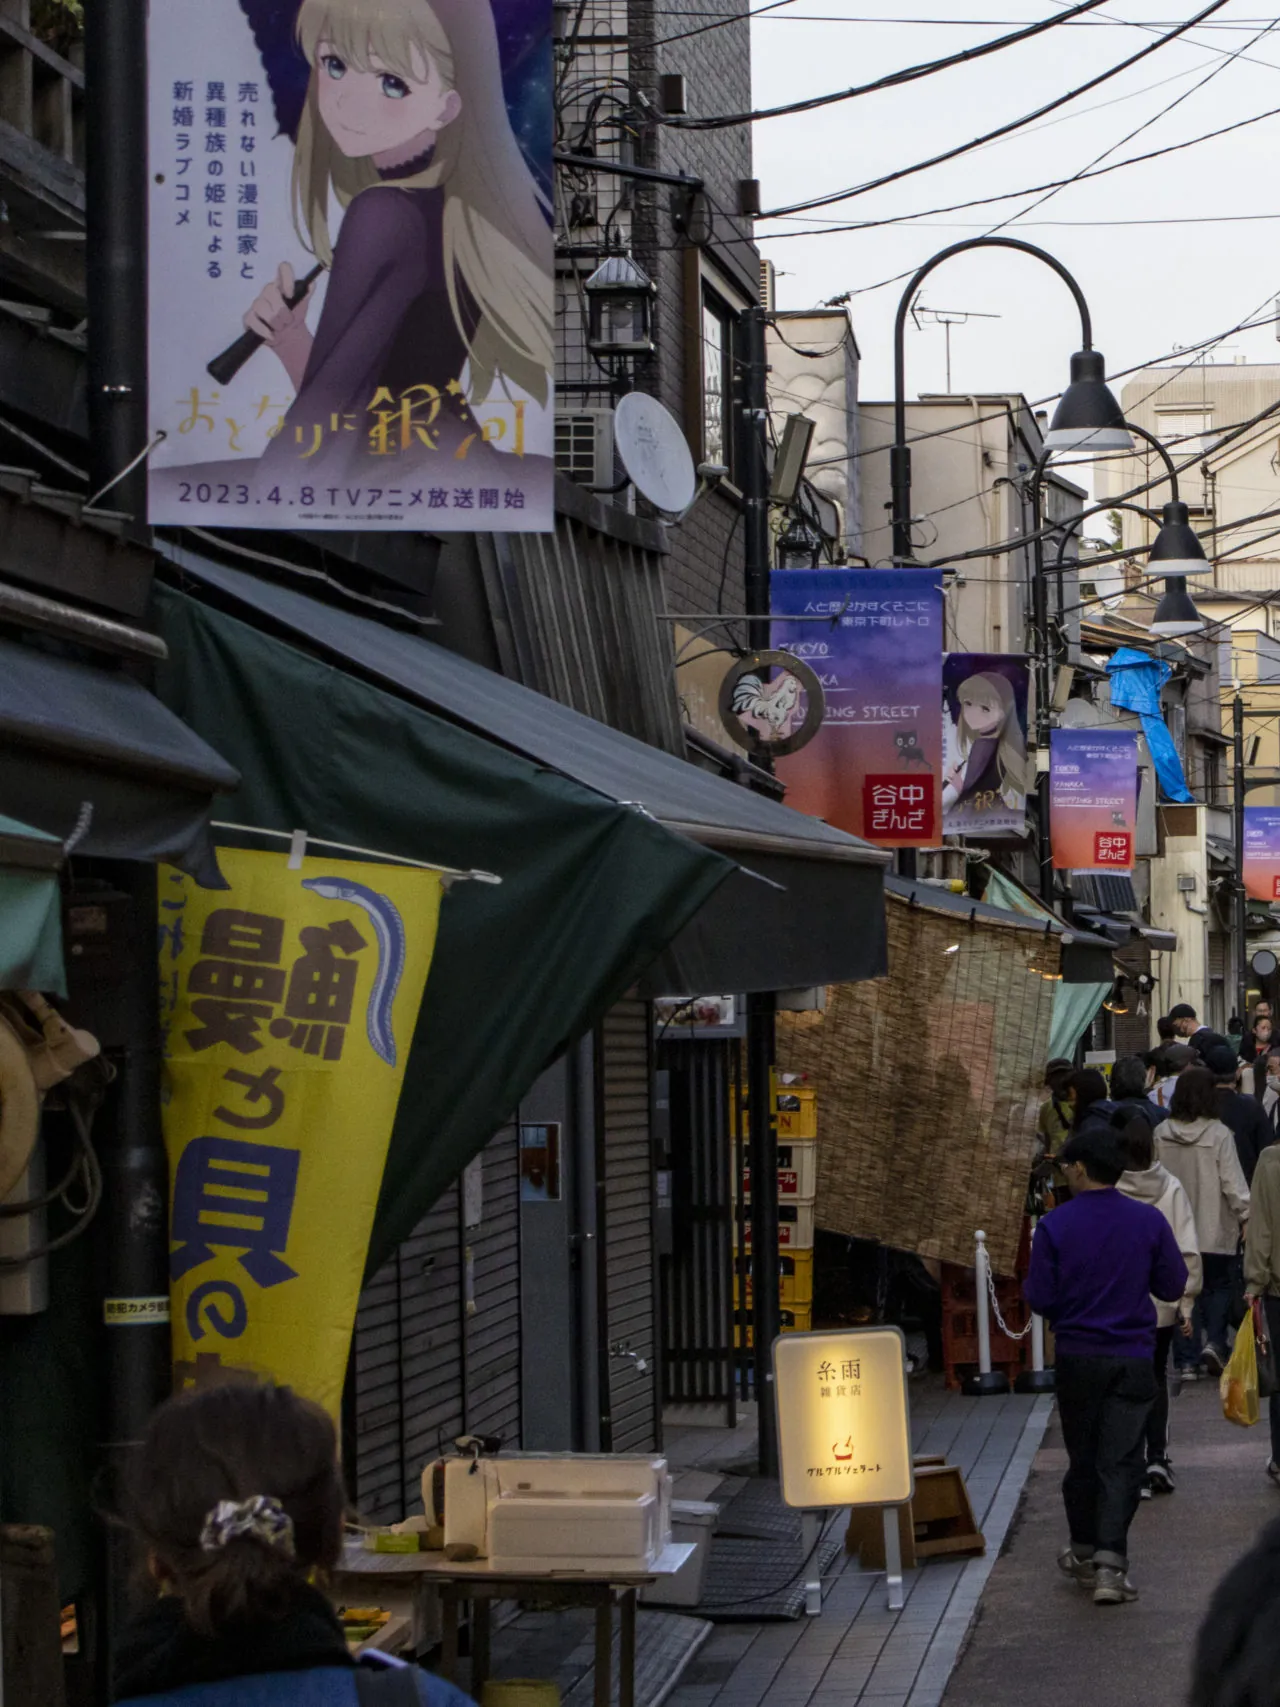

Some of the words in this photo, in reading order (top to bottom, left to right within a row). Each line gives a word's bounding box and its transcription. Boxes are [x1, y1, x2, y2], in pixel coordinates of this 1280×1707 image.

[172, 79, 195, 228] 新婚ラブコメ
[203, 80, 227, 281] 異種族の姫による
[236, 80, 259, 282] 売れない漫画家と
[174, 381, 530, 460] おとなりに銀河
[178, 482, 316, 507] 2023.4.8
[326, 487, 526, 510] TVアニメ放送開始
[841, 616, 931, 627] 東京下町レトロ
[863, 705, 921, 718] STREET
[872, 784, 924, 806] 谷中
[872, 808, 926, 830] ぎんざ
[1098, 836, 1127, 848] 谷中
[1098, 848, 1127, 861] ぎんざ
[816, 1357, 861, 1382] 糸雨
